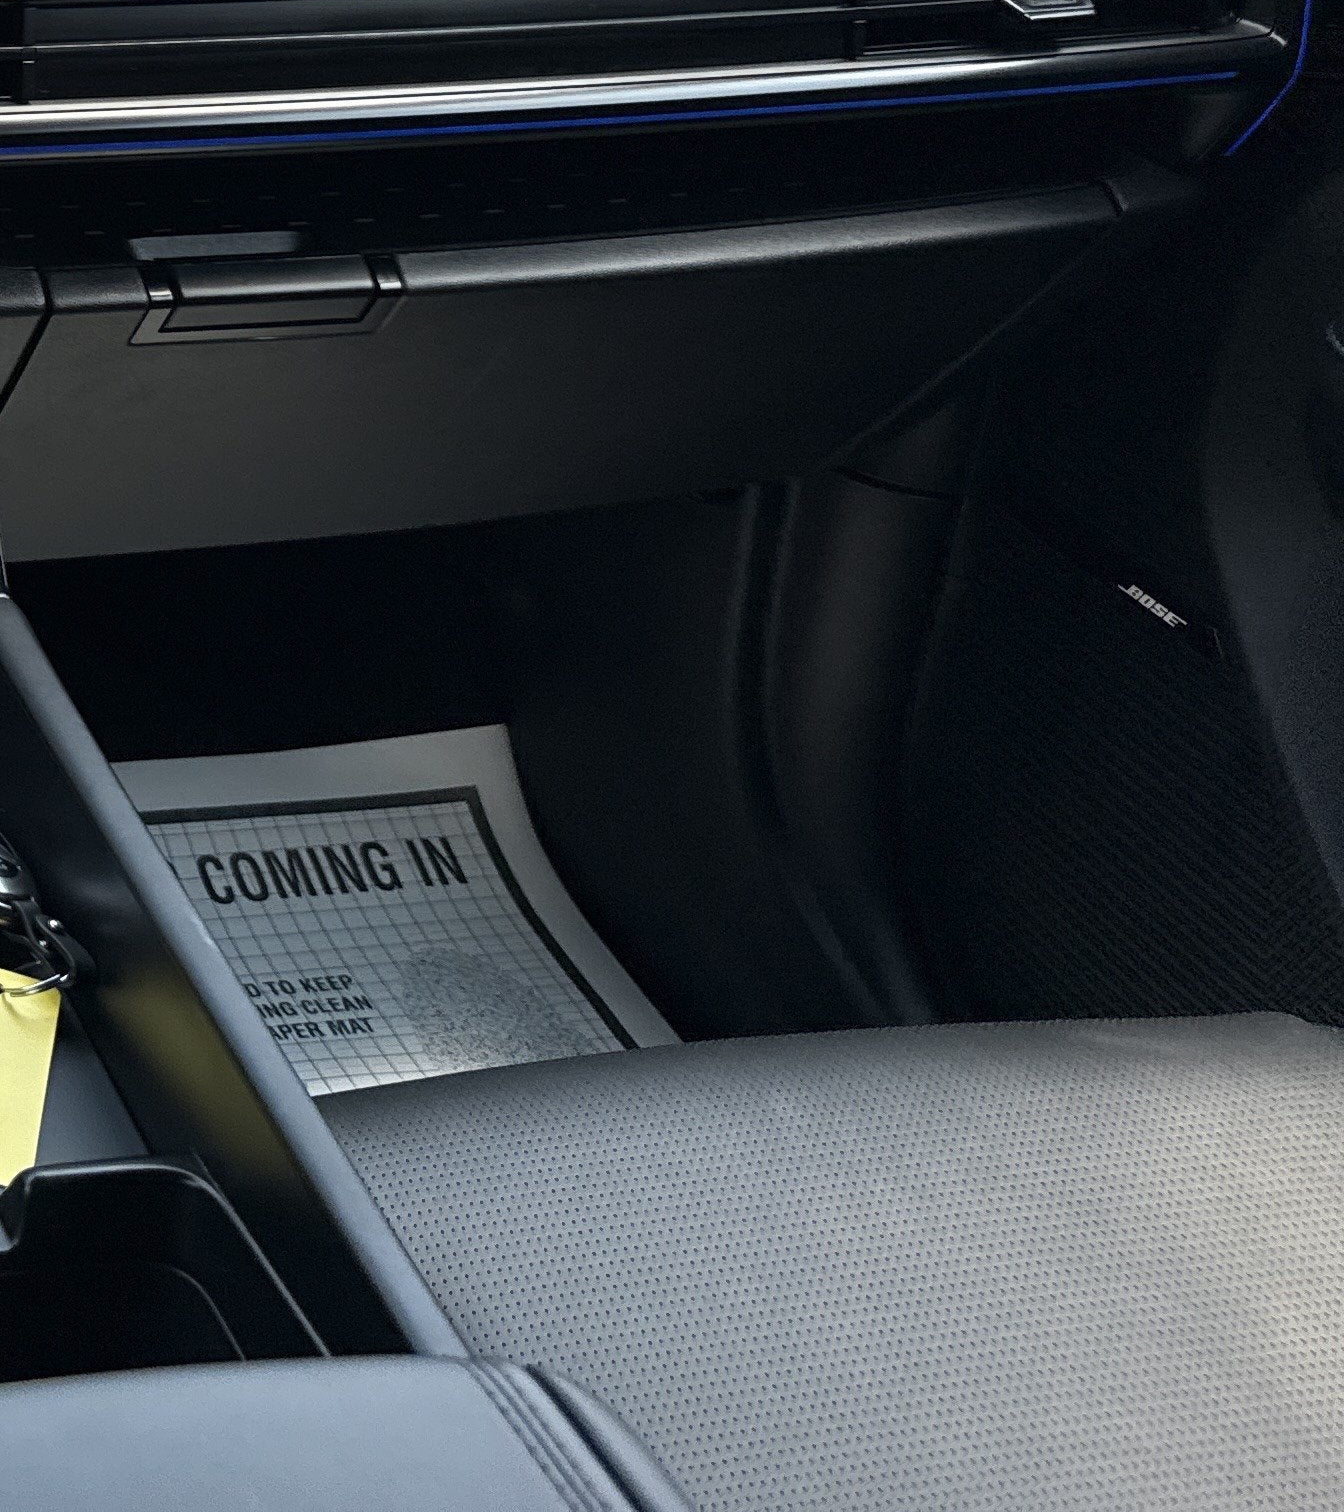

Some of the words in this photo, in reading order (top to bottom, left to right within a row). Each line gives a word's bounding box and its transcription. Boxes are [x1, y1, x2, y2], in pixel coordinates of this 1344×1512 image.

[1117, 584, 1188, 628] BOSE
[196, 841, 403, 905] COMING
[407, 836, 468, 886] IN
[262, 979, 296, 996] TO
[298, 974, 353, 993] KEEP
[300, 996, 373, 1014] CLEAN
[326, 1017, 374, 1036] MAT
